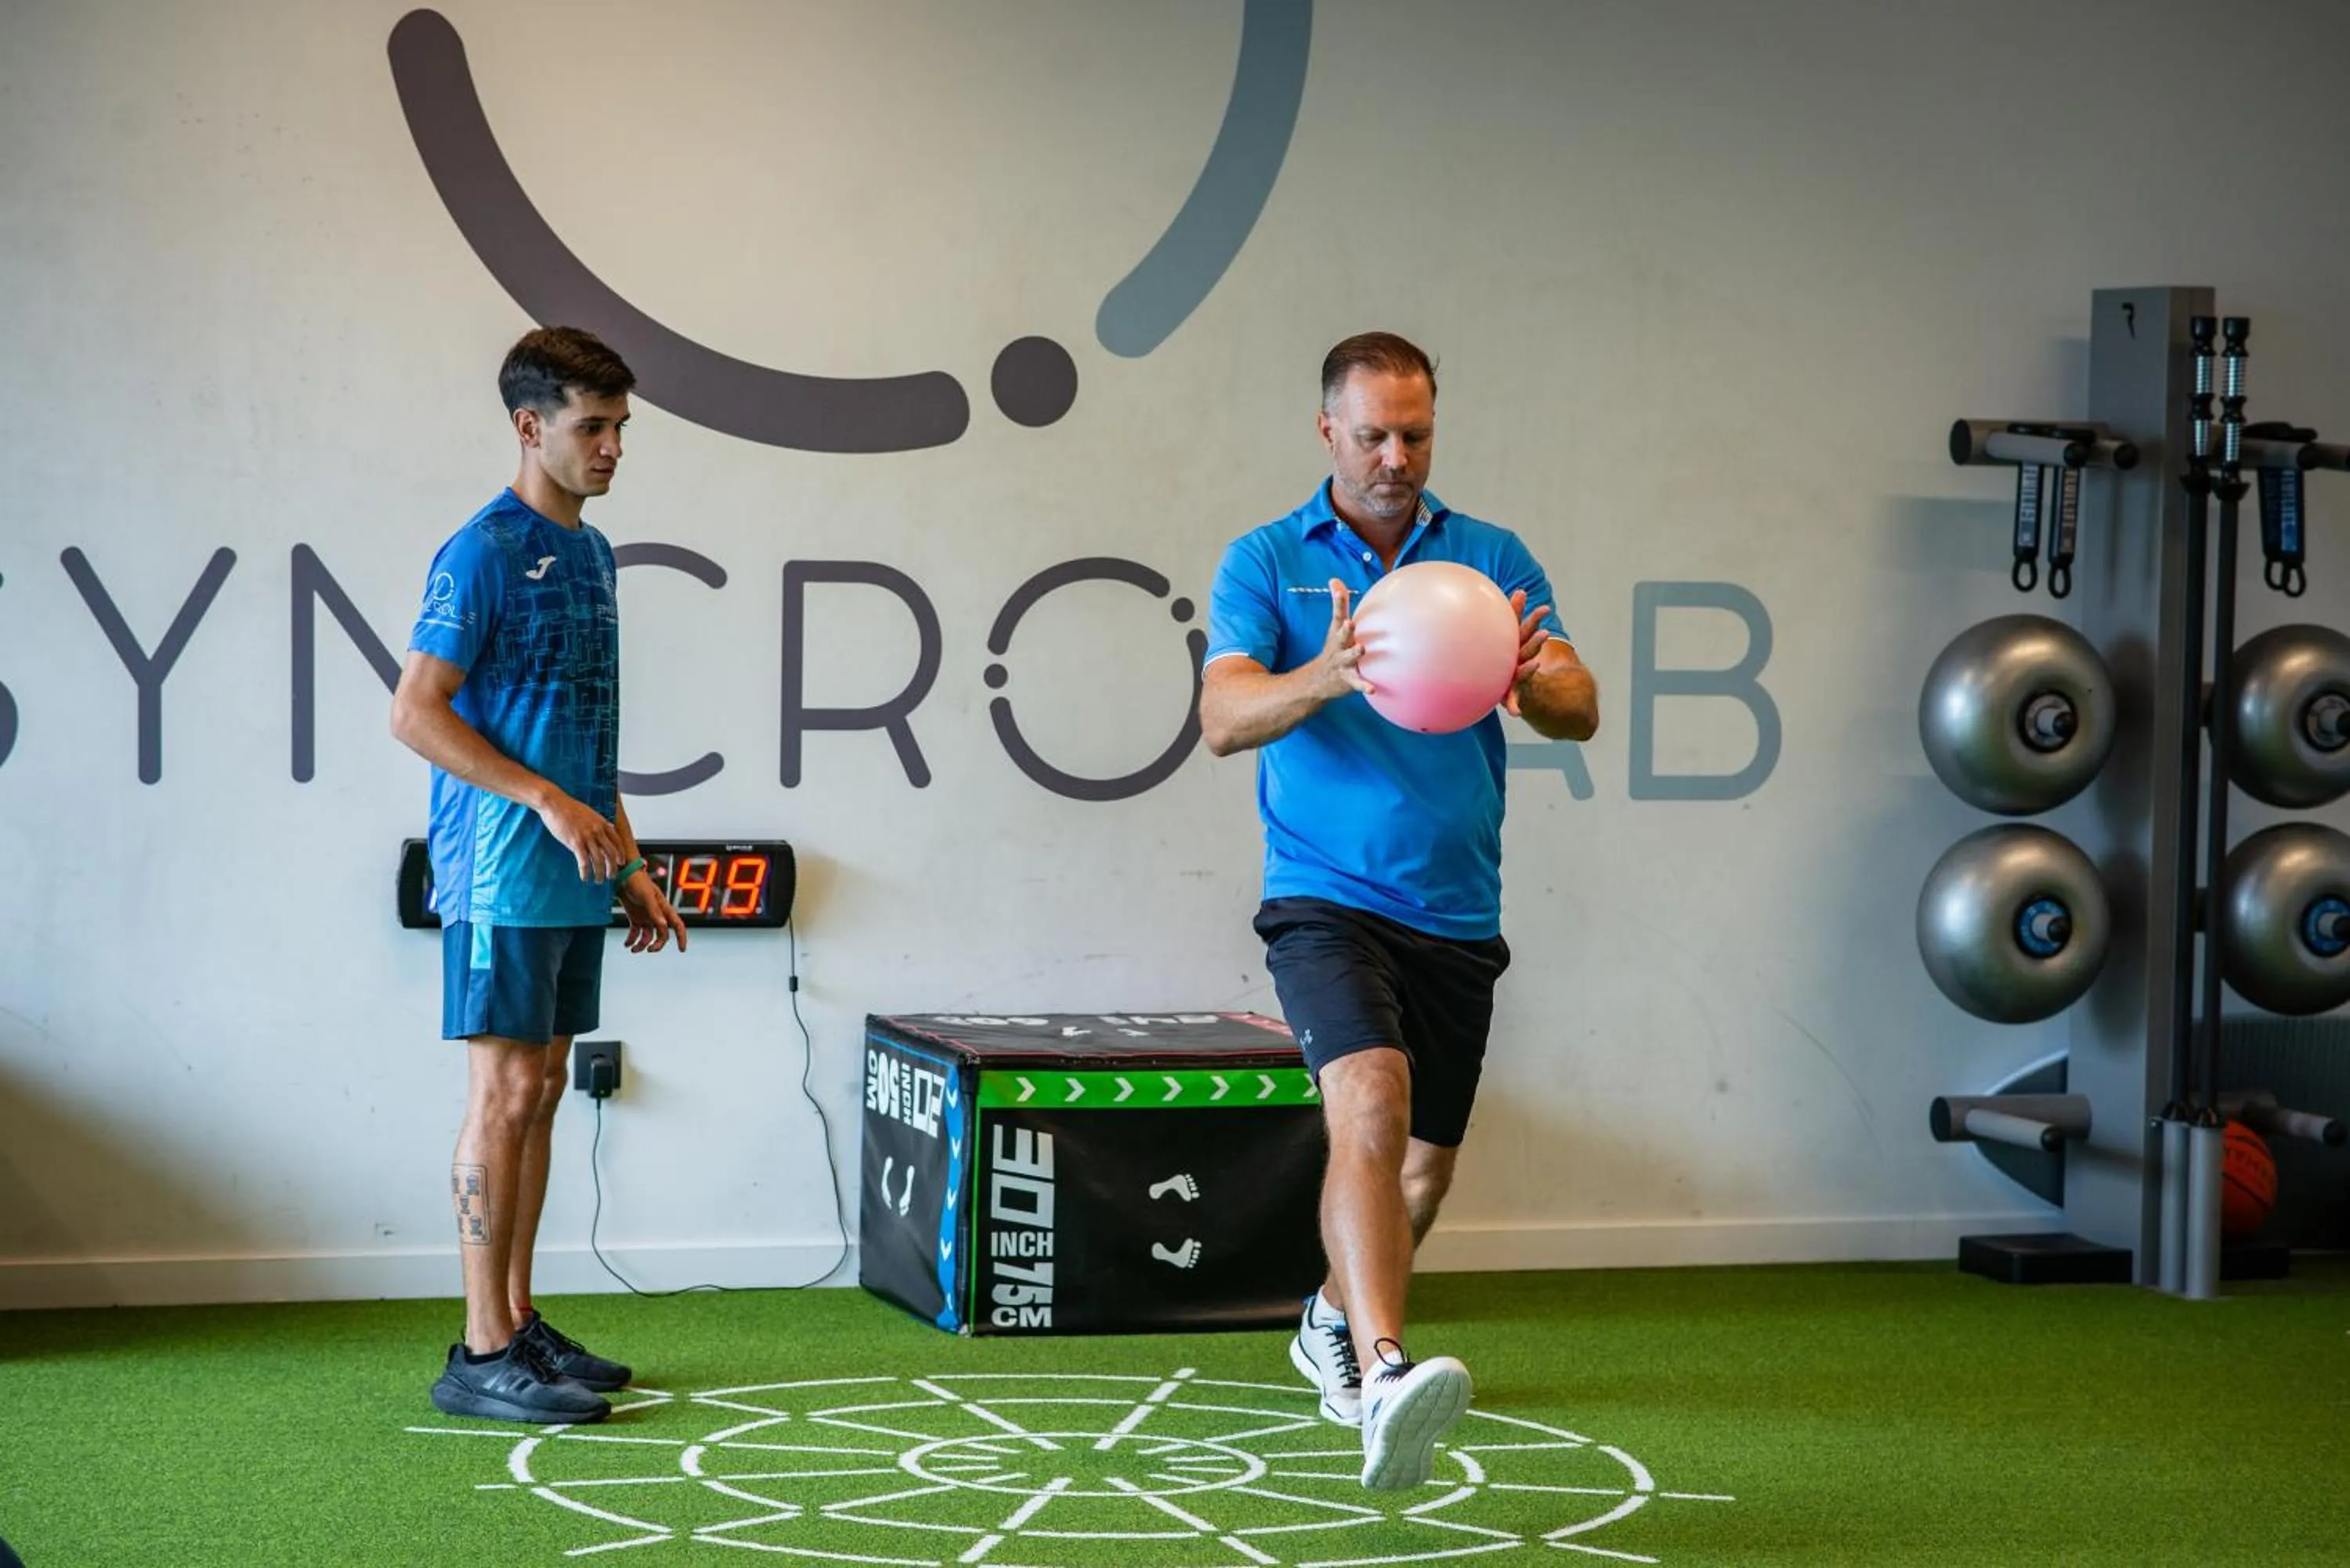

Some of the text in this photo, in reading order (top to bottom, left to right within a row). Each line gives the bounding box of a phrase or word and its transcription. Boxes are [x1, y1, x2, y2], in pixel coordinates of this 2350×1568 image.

[990, 1124, 1054, 1328] 30 INCH 75 CM
